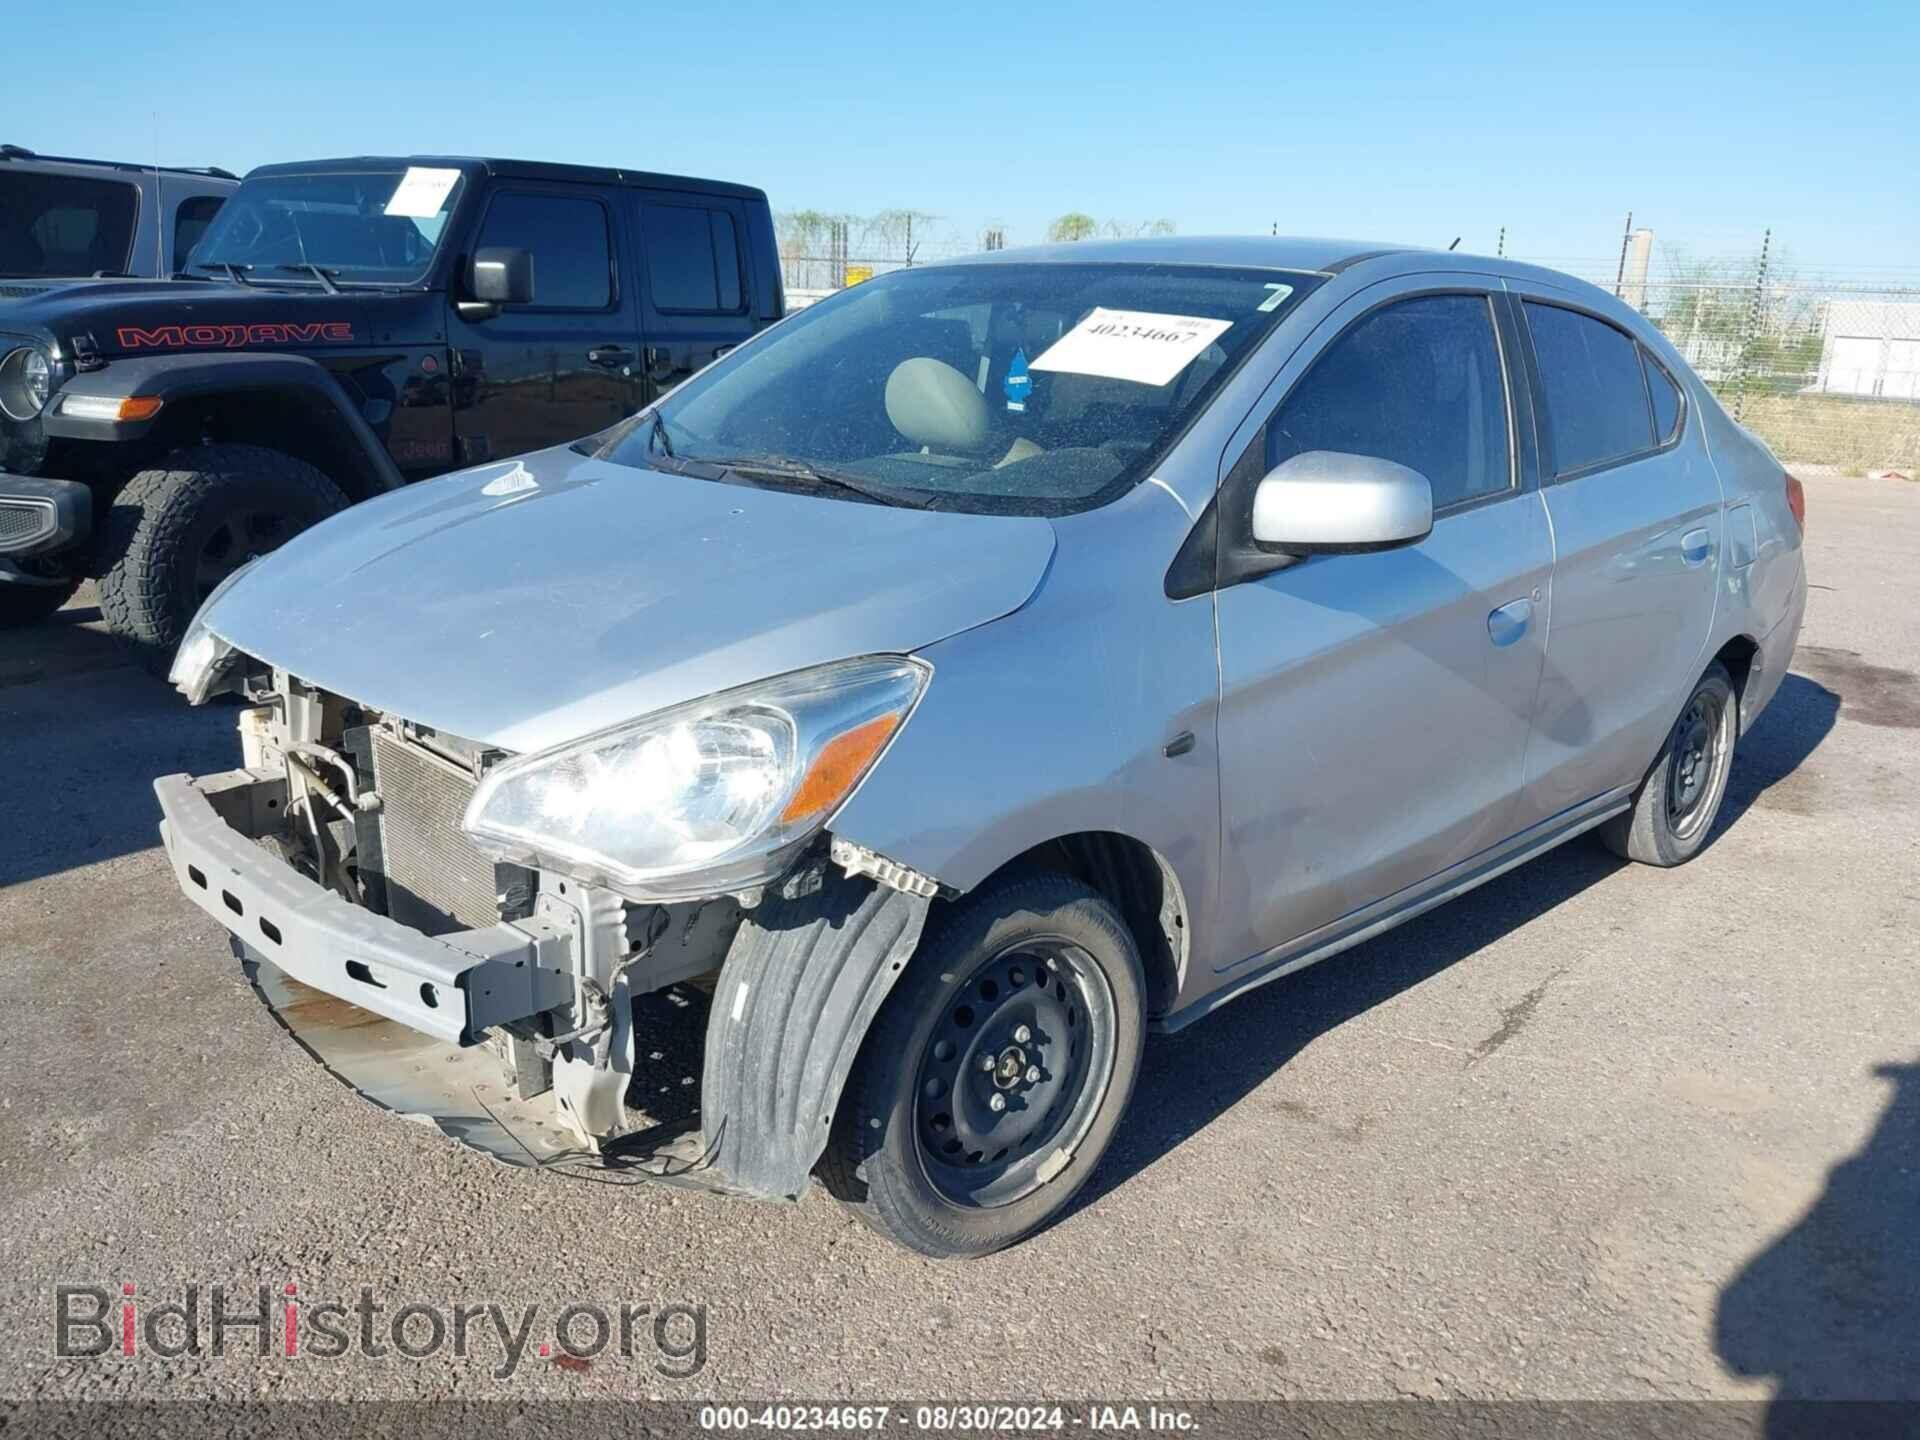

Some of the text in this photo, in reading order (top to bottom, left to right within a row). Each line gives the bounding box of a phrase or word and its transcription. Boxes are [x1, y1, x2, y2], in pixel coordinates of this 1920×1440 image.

[1256, 283, 1294, 313] 7
[117, 323, 355, 347] MOJAVE
[1087, 323, 1199, 343] 40234667
